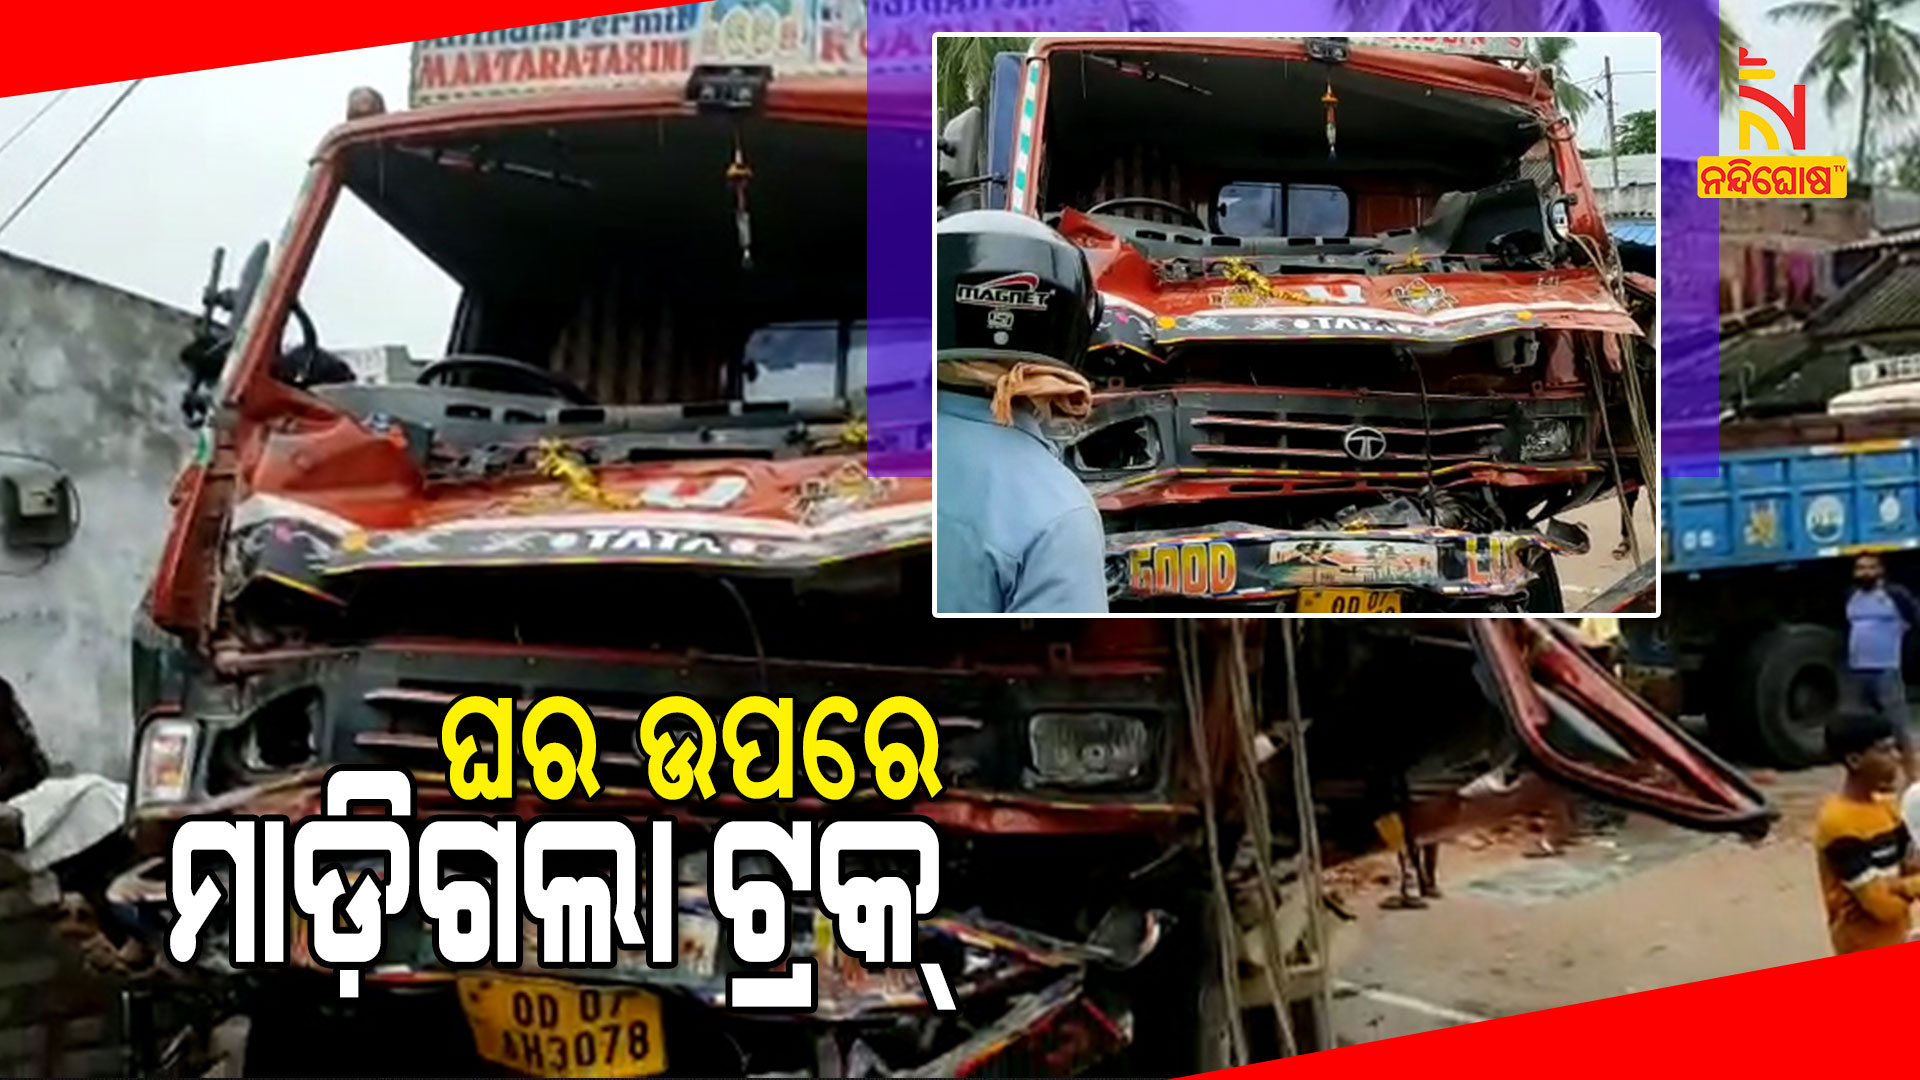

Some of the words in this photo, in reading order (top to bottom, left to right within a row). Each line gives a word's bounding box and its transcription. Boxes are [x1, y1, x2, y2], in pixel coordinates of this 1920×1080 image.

[955, 283, 1049, 308] MAGNET
[586, 528, 722, 554] TATA
[513, 990, 559, 1029] OD
